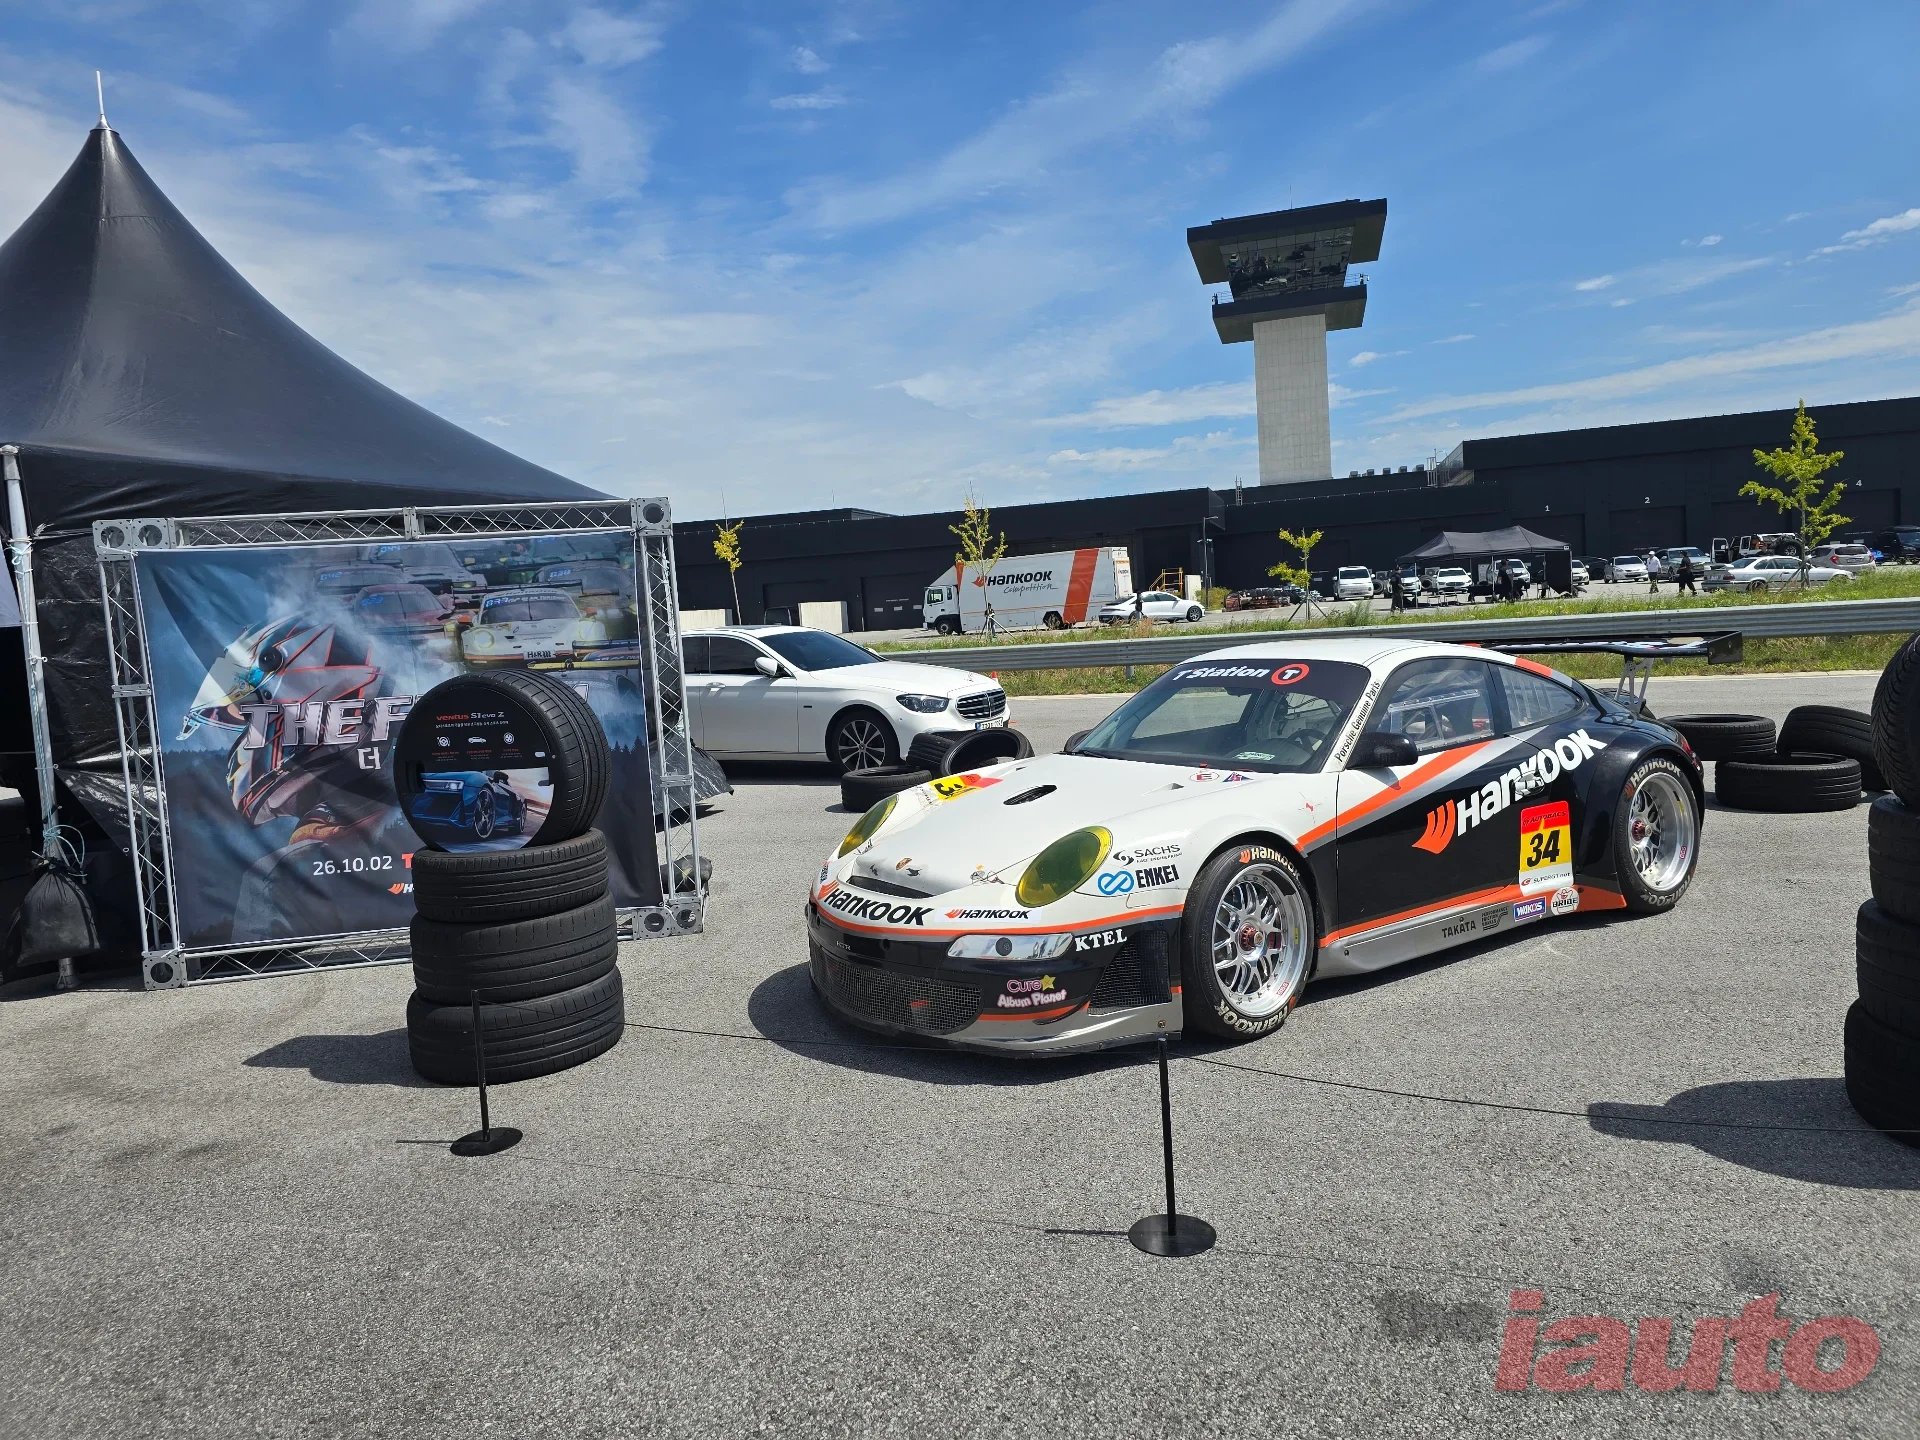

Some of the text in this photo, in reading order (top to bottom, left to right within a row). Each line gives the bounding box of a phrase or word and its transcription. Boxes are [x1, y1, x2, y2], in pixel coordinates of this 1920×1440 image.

[1856, 479, 1862, 487] 4
[1544, 504, 1550, 512] 1
[1644, 496, 1650, 504] 2
[239, 698, 366, 750] THE
[1334, 681, 1381, 763] Porsche Genuine Parts
[357, 746, 381, 770] 더
[1134, 844, 1181, 858] SACHS
[1526, 829, 1560, 868] 34
[312, 855, 393, 876] 26.10.02
[1135, 863, 1180, 889] ENKEI
[1552, 897, 1578, 909] BRIDE
[1441, 920, 1477, 939] TAKATA
[1074, 928, 1128, 952] KTEL
[1006, 979, 1042, 993] Cure
[997, 989, 1068, 1008] Album Planet
